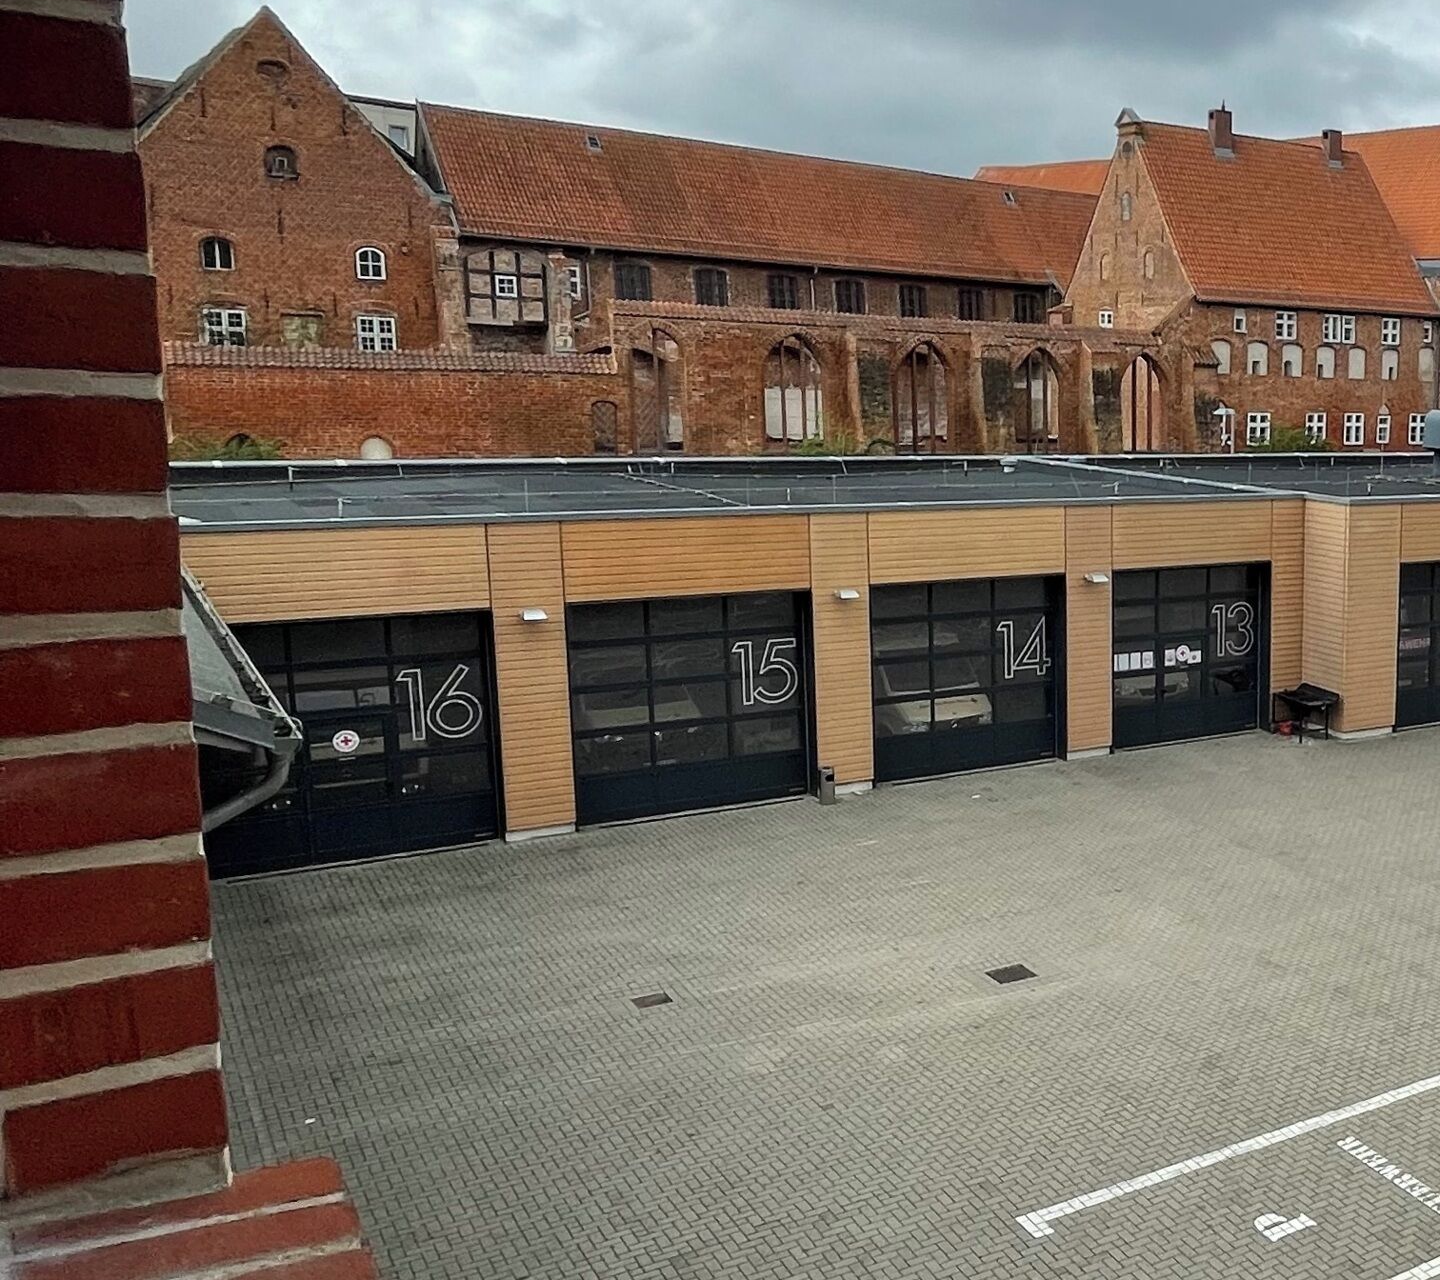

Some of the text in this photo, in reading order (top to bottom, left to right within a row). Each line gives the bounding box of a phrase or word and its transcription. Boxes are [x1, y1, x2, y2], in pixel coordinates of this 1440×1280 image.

[996, 615, 1052, 680] 14
[1212, 602, 1254, 657] 13
[395, 664, 483, 741] 16
[730, 637, 799, 706] 15
[1253, 1212, 1317, 1242] P
